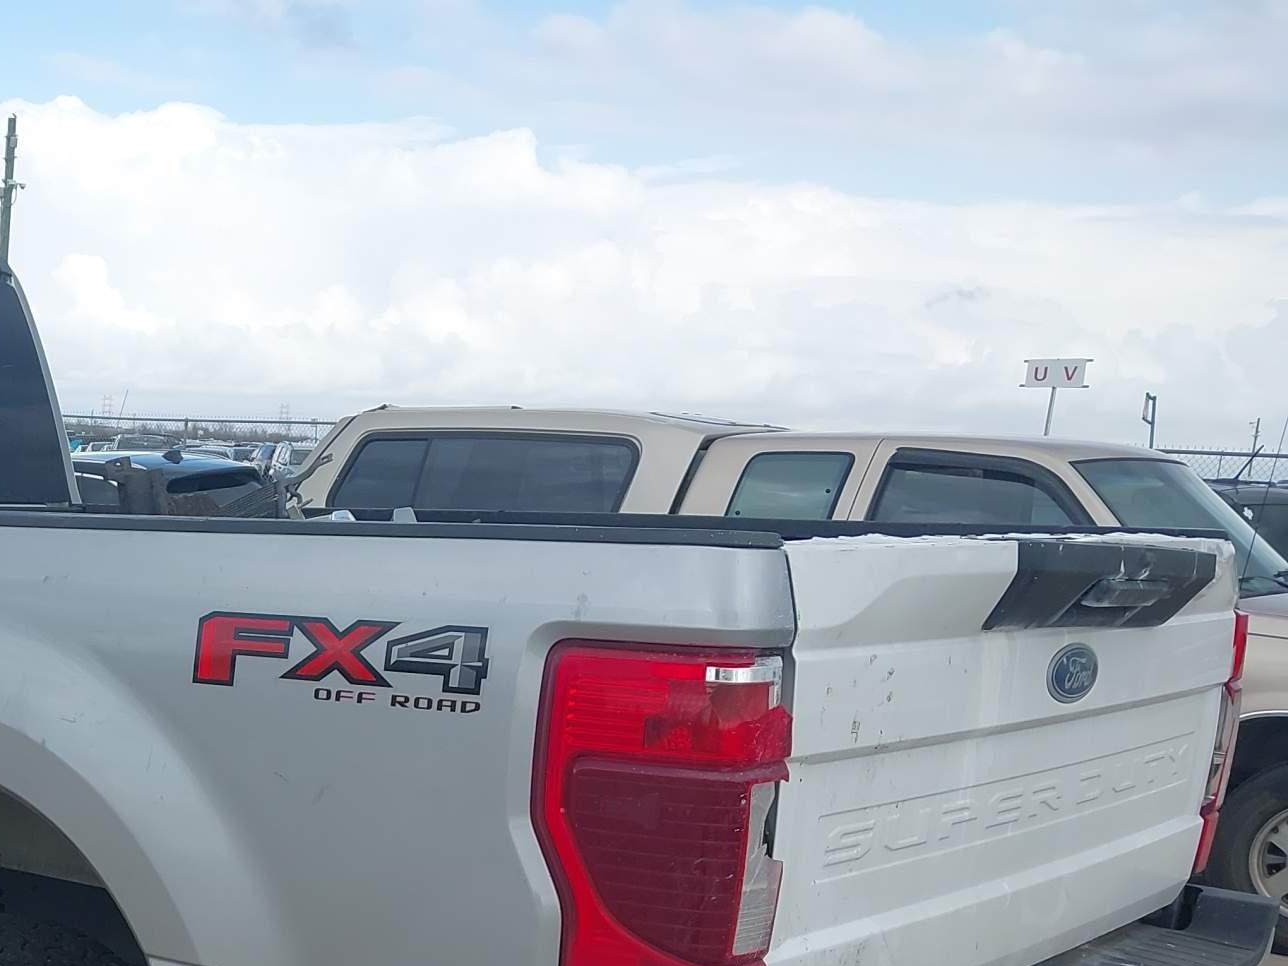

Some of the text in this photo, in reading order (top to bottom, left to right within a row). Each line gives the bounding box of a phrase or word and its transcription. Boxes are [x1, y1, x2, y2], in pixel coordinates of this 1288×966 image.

[1033, 366, 1078, 382] U V
[192, 611, 489, 696] FX4
[1064, 656, 1095, 689] Ford
[313, 687, 481, 714] OFF ROAD
[823, 744, 1189, 868] SUPER DUTY
